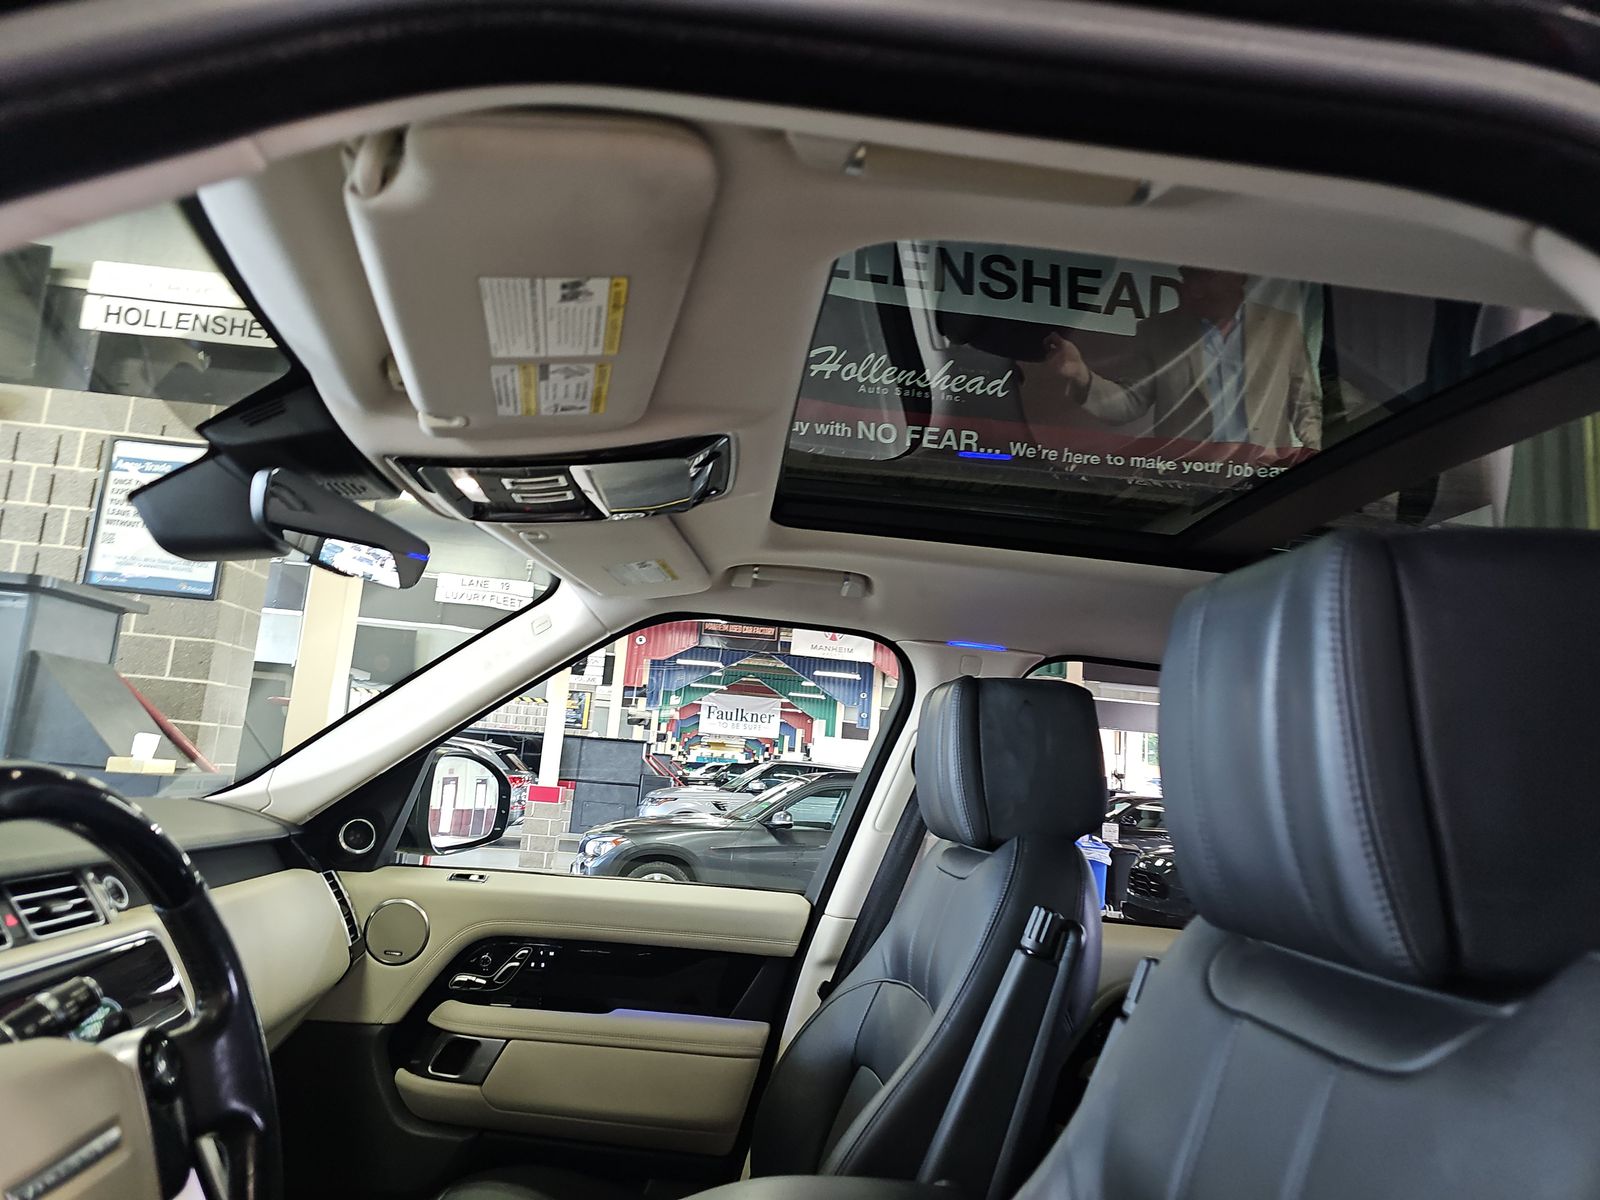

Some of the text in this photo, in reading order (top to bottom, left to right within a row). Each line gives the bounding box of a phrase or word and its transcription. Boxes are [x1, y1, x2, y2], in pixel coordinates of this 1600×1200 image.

[104, 304, 271, 340] HOLLENSHE
[809, 345, 1014, 398] Hollenshead
[857, 384, 889, 395] Auto
[815, 420, 852, 438] with
[857, 421, 898, 444] NO
[906, 425, 1001, 454] FEAR...
[1009, 441, 1058, 461] We're
[1062, 447, 1101, 465] here
[1106, 453, 1125, 466] to
[1130, 456, 1177, 471] make
[1182, 460, 1223, 474] your
[1226, 460, 1254, 478] job
[461, 578, 490, 589] LANE
[490, 595, 524, 608] FLEET
[810, 643, 855, 654] MANHEIM
[706, 705, 775, 724] Faulkner
